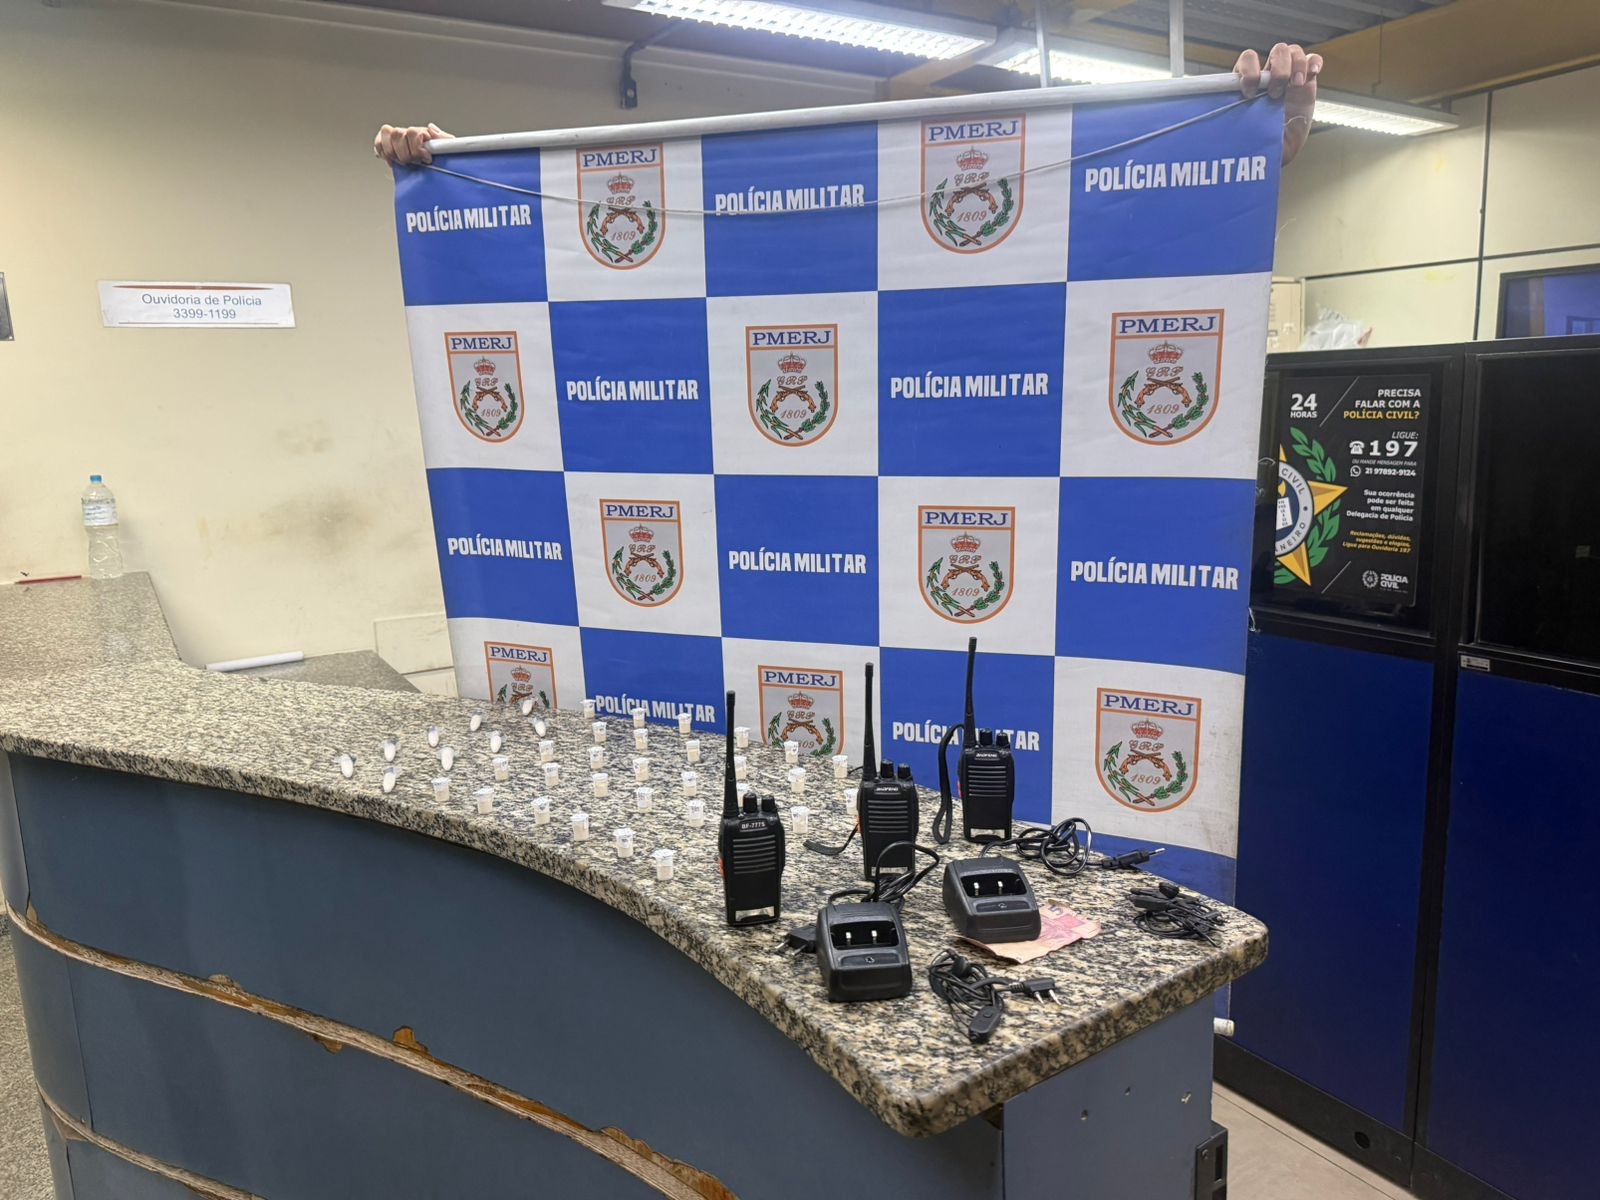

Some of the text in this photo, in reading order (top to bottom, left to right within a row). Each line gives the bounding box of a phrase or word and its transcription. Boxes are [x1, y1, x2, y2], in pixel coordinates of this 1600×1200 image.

[928, 120, 1019, 141] PMERJ
[583, 149, 657, 167] PMERJ
[1085, 156, 1267, 193] POLÍCIA MILITAR
[715, 184, 865, 216] POLÍCIA MILITAR
[406, 204, 532, 233] POLÍCIA MILITAR
[957, 211, 987, 222] 1809
[611, 231, 636, 241] 1809
[142, 294, 201, 304] Ouvidoria
[204, 295, 220, 305] de
[173, 308, 236, 319] 3399-1199
[1120, 316, 1216, 334] PMERJ
[451, 337, 512, 350] PMERJ
[752, 331, 831, 345] PMERJ
[567, 376, 699, 401] POLÍCIA MILITAR
[890, 371, 1049, 399] POLÍCIA MILITAR
[1377, 389, 1421, 397] PRECISA
[1291, 393, 1318, 411] 24
[1355, 400, 1420, 408] FALAR COM A
[481, 408, 501, 417] 1809
[781, 409, 807, 419] 1809
[1147, 404, 1179, 414] 1809
[1343, 408, 1420, 419] POLÍCIA CIVIL?
[1391, 431, 1419, 440] LIGUE:
[1369, 440, 1418, 457] 197
[1281, 468, 1305, 494] CIVIL
[1378, 490, 1415, 498] ocorrência
[605, 505, 674, 518] PMERJ
[1346, 510, 1378, 518] Delegacia
[1383, 506, 1414, 514] qualquer
[925, 511, 1008, 526] PMERJ
[447, 533, 562, 561] POLÍCIA MILITAR
[729, 547, 867, 574] POLÍCIA MILITAR
[634, 574, 656, 583] 1809
[1071, 557, 1239, 590] POLÍCIA MILITAR
[952, 588, 980, 597] 1809
[490, 646, 547, 662] PMERJ
[764, 671, 837, 687] PMERJ
[1104, 694, 1194, 716] PMERJ
[1131, 774, 1161, 784] 1809
